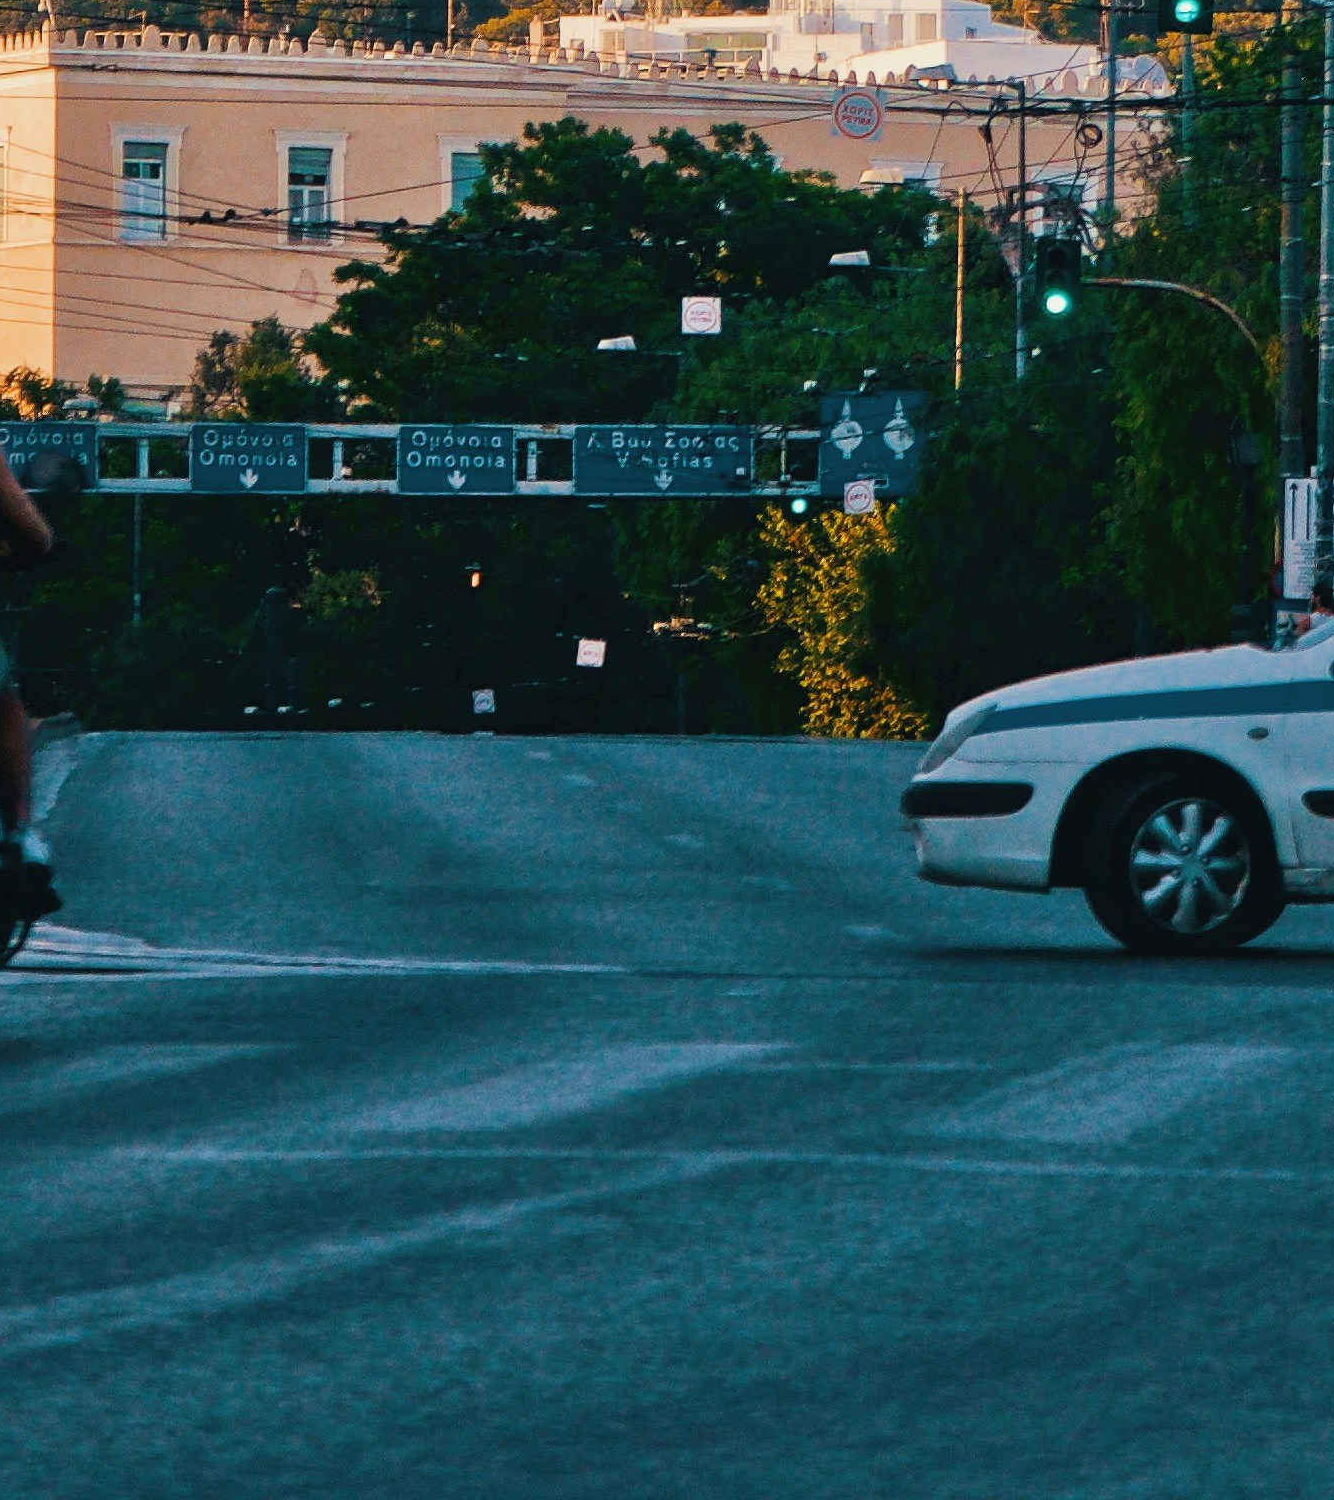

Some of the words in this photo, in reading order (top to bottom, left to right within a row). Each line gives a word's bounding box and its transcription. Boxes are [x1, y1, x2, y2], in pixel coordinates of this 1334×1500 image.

[203, 428, 295, 450] Ομόνοια
[411, 429, 503, 451] Ομόνοια
[199, 449, 299, 467] Omonoia
[406, 450, 507, 469] Omonoia
